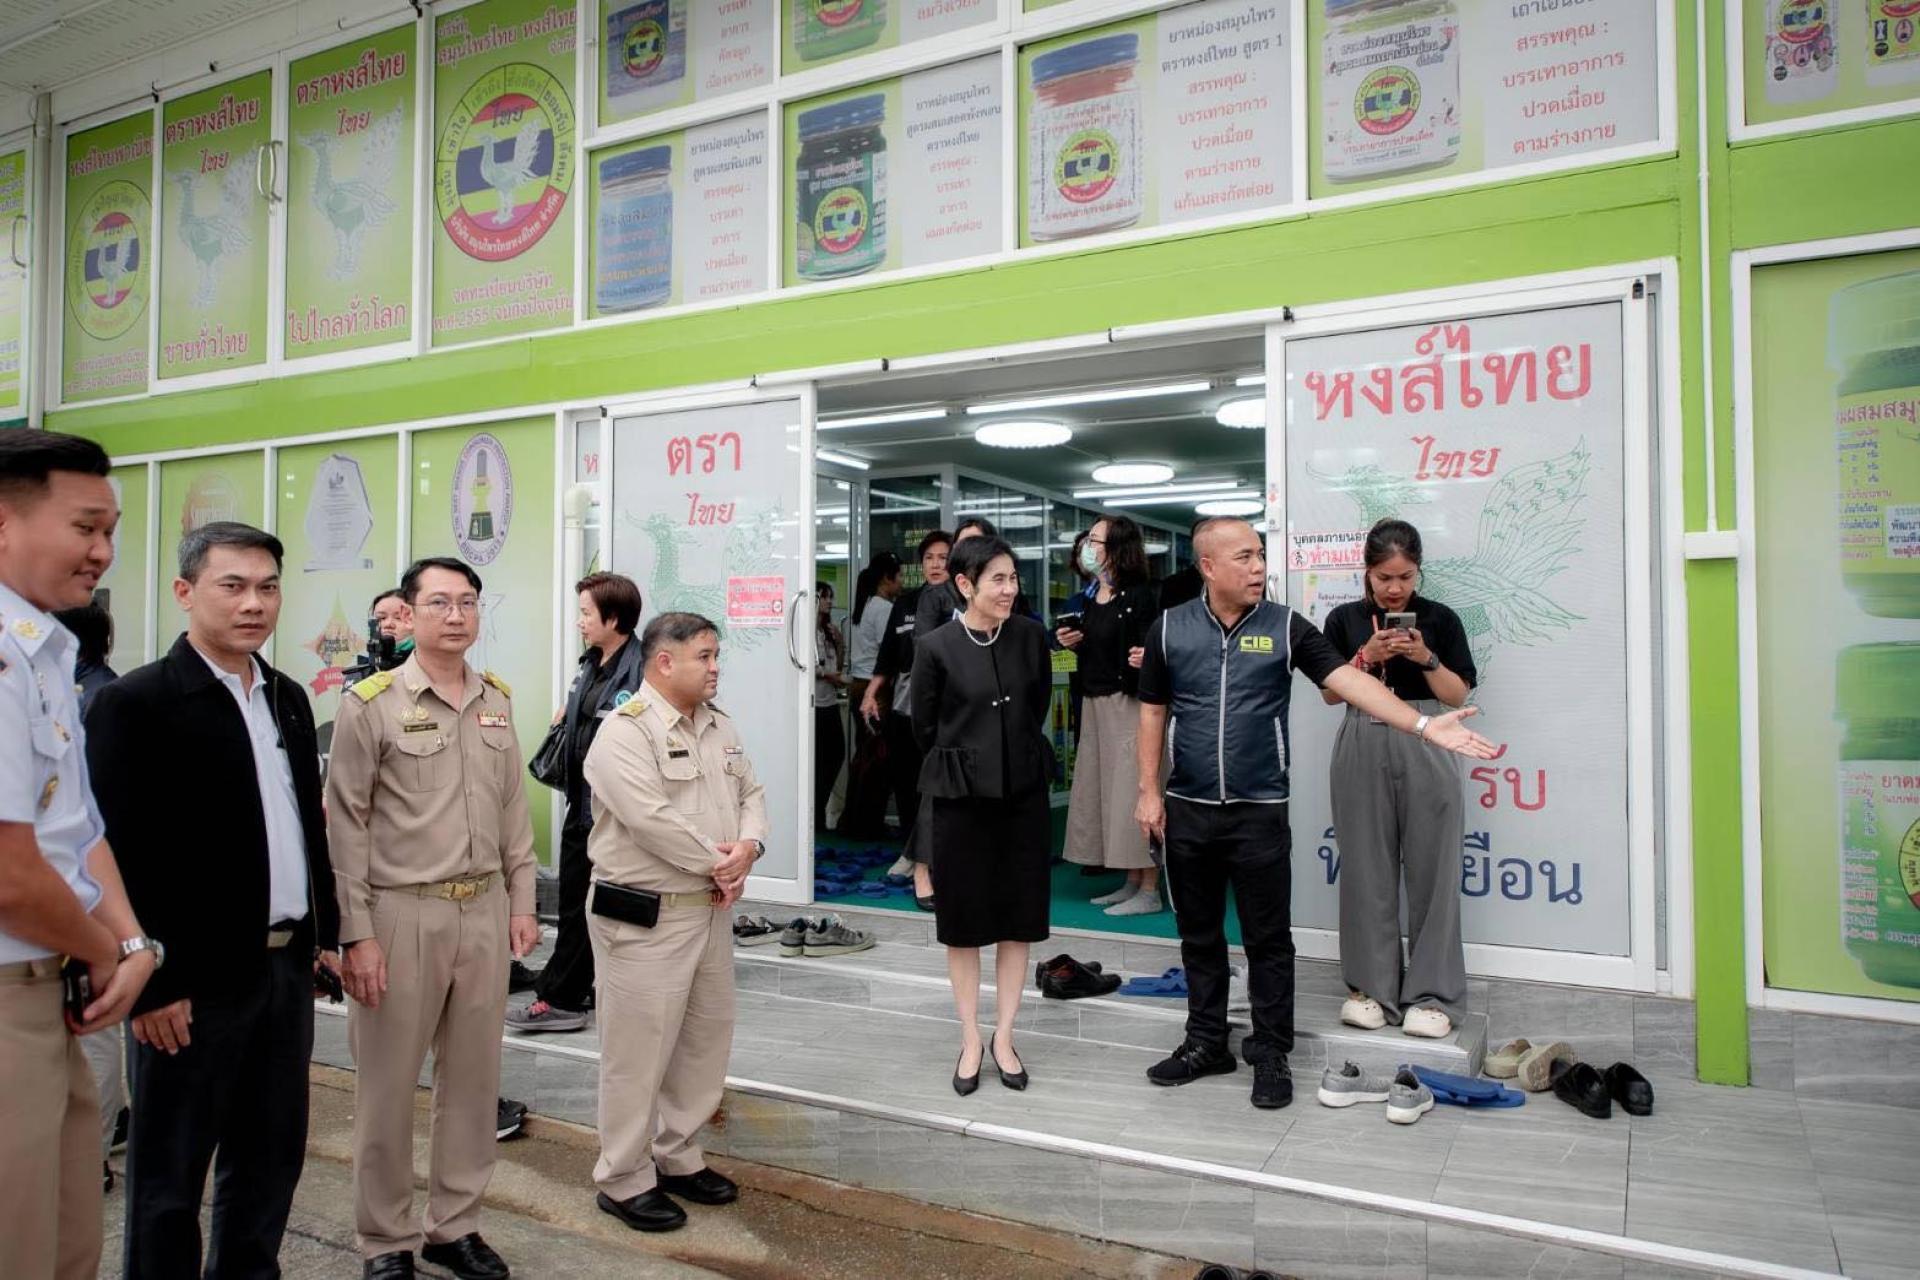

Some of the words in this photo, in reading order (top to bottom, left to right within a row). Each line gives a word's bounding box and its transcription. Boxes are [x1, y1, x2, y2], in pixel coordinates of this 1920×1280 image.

[1169, 7, 1276, 43] ยาหม่องสมุนไพร
[1516, 23, 1596, 51] สรรพคุณ
[1162, 43, 1237, 73] ตราหงส์ไทย
[1243, 38, 1270, 59] สูตร
[1503, 51, 1626, 88] บรรเทาอาการ
[297, 49, 406, 105] ตราหงส์ไทย
[1188, 71, 1248, 95] สรรพคุณ
[1178, 98, 1269, 126] บรรเทาอาการ
[1522, 85, 1606, 119] ปวดเมื่อย
[165, 96, 261, 145] ตราหงส์ไทย
[337, 107, 371, 136] ไทย
[1192, 125, 1255, 151] ปวดเมื่อย
[1513, 122, 1617, 154] ตามร่างกาย
[200, 148, 230, 175] ไทย
[1184, 155, 1262, 182] ตามร่างกาย
[288, 294, 406, 343] ไปไกลทั่วโลก
[165, 324, 248, 365] ขายทั่วไทย
[1305, 324, 1592, 421] หงส์ไทย
[667, 432, 742, 476] ตรา
[1411, 435, 1502, 480] ไทย
[685, 492, 736, 526] ไทย
[1310, 541, 1364, 564] ห้ามเข้
[1240, 636, 1273, 650] CIB
